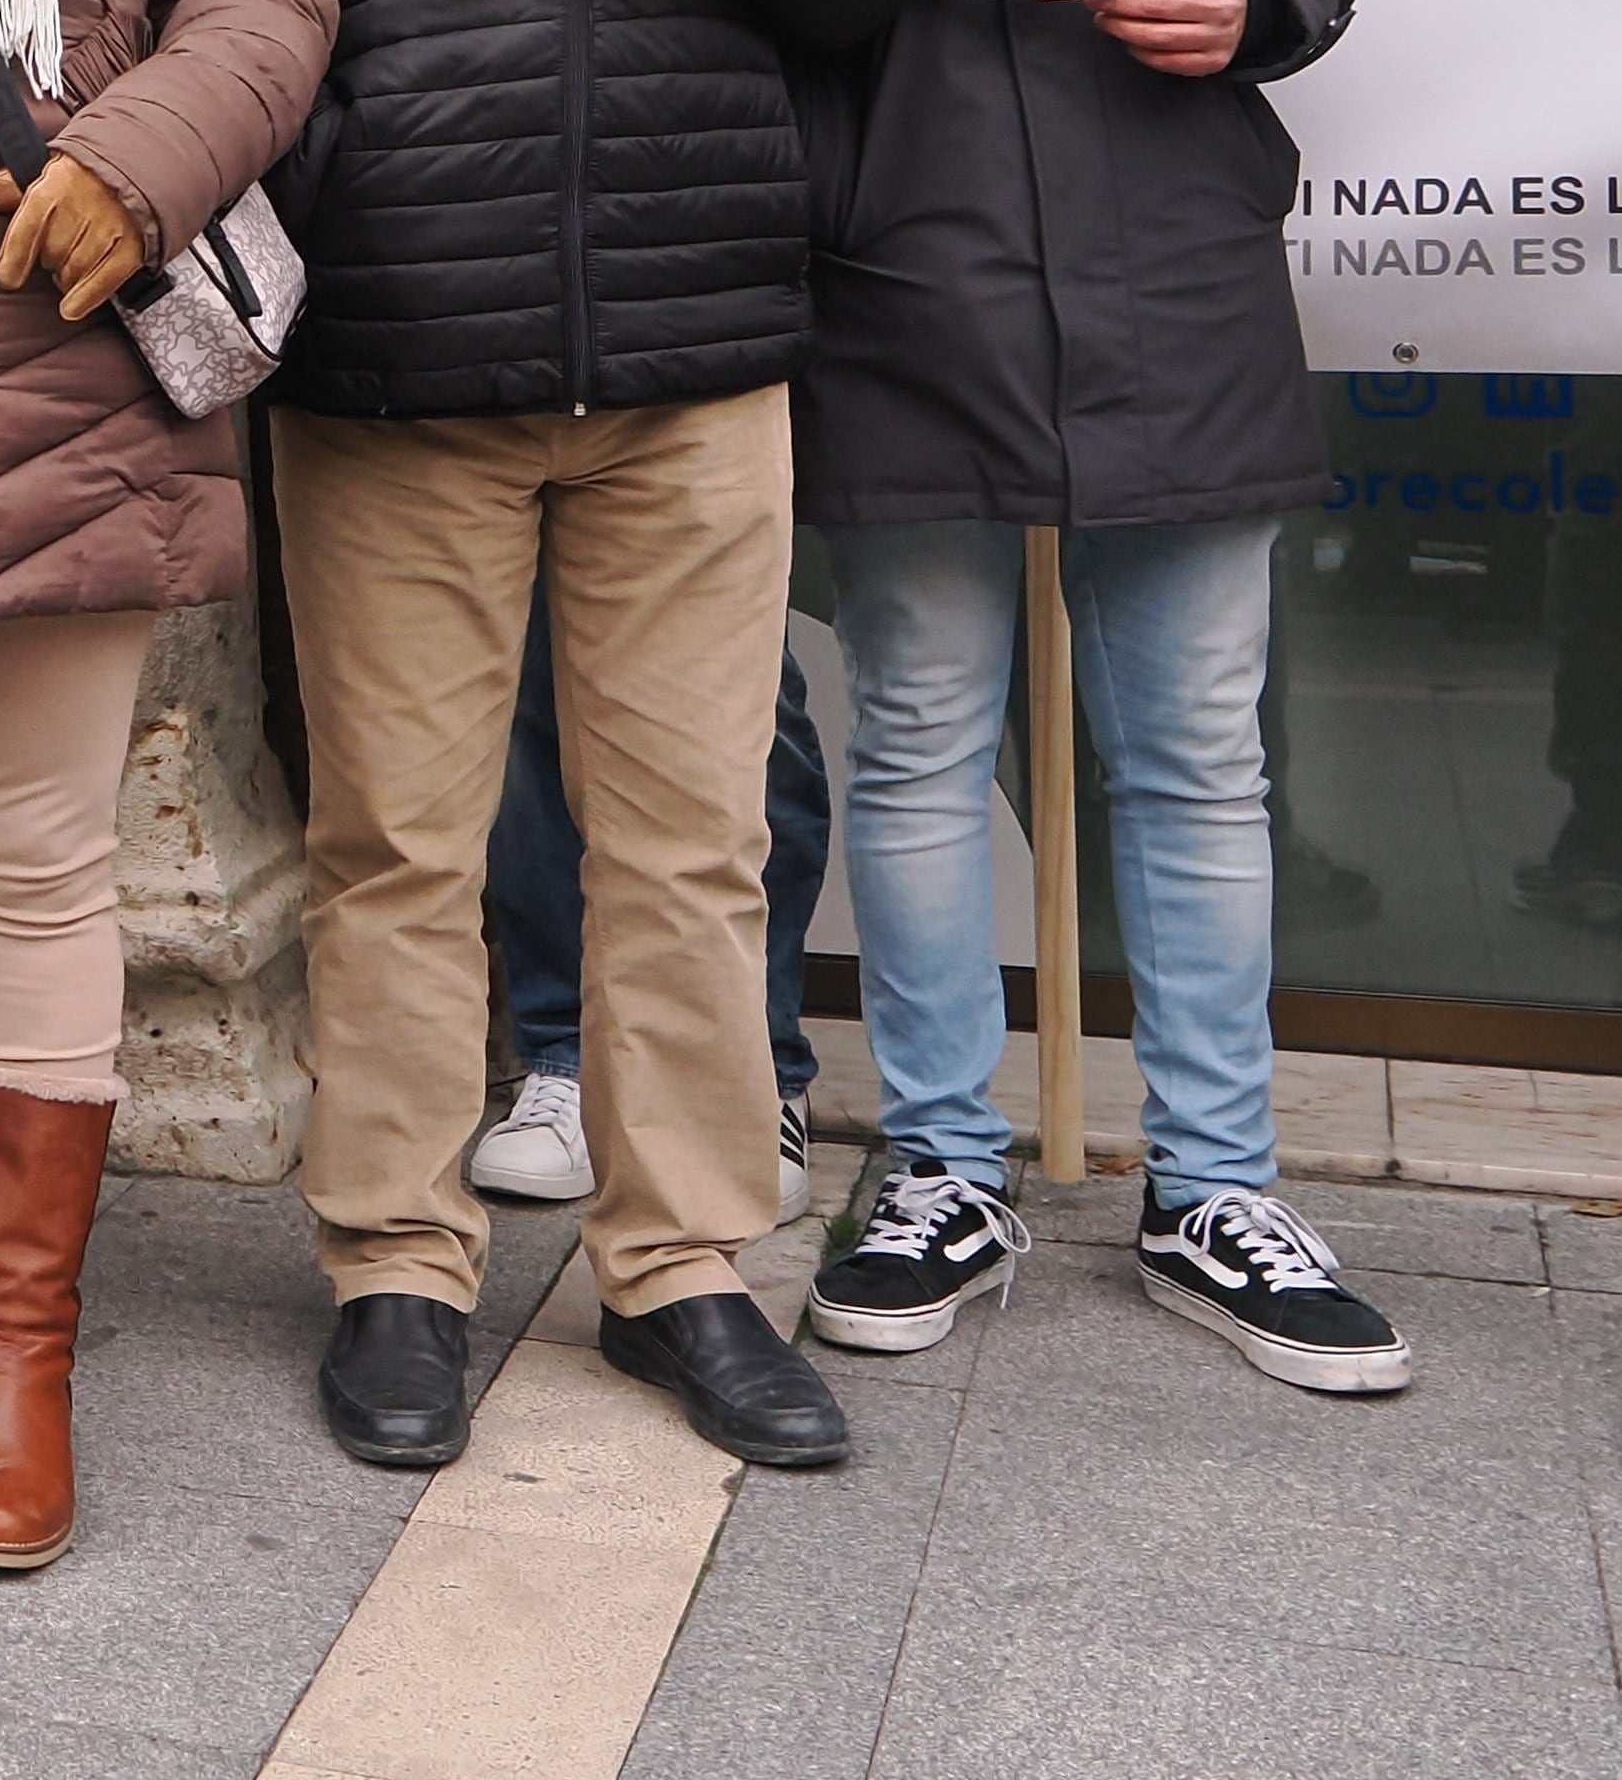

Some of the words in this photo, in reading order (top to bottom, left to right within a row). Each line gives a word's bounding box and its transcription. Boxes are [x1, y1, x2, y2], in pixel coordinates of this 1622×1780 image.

[1333, 177, 1494, 216] NADA
[1511, 175, 1586, 215] ES
[1333, 238, 1495, 277] NADA
[1512, 237, 1587, 276] ES
